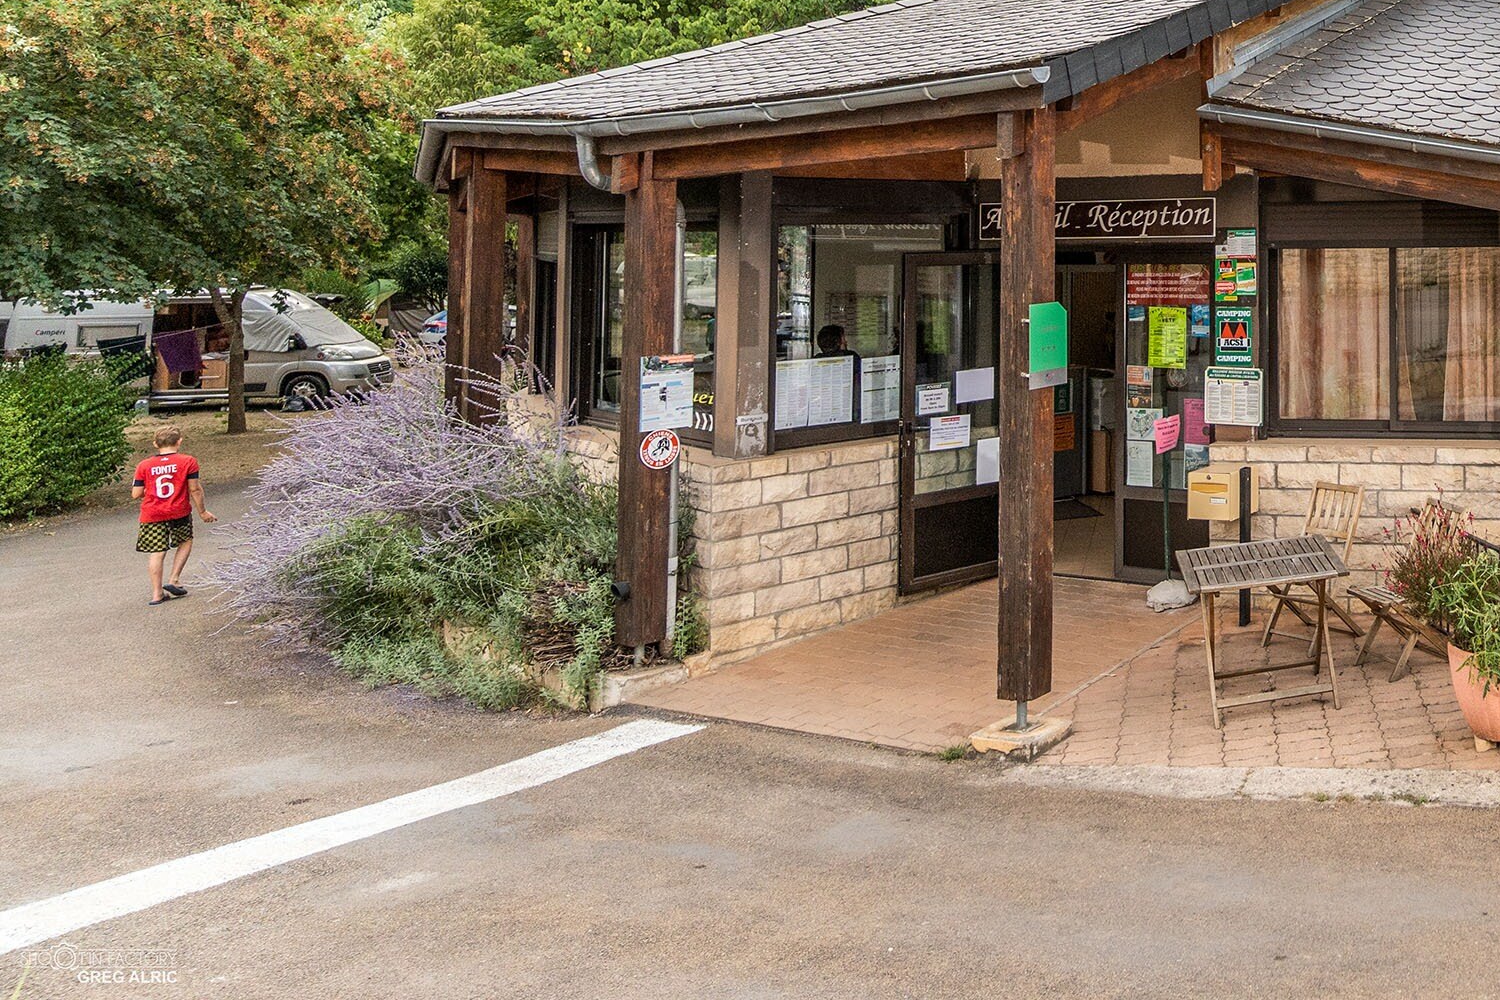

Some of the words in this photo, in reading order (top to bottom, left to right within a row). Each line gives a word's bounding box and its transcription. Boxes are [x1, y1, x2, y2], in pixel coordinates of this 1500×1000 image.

[1087, 199, 1213, 238] Réception
[151, 464, 178, 476] FONTE
[155, 474, 175, 499] 6
